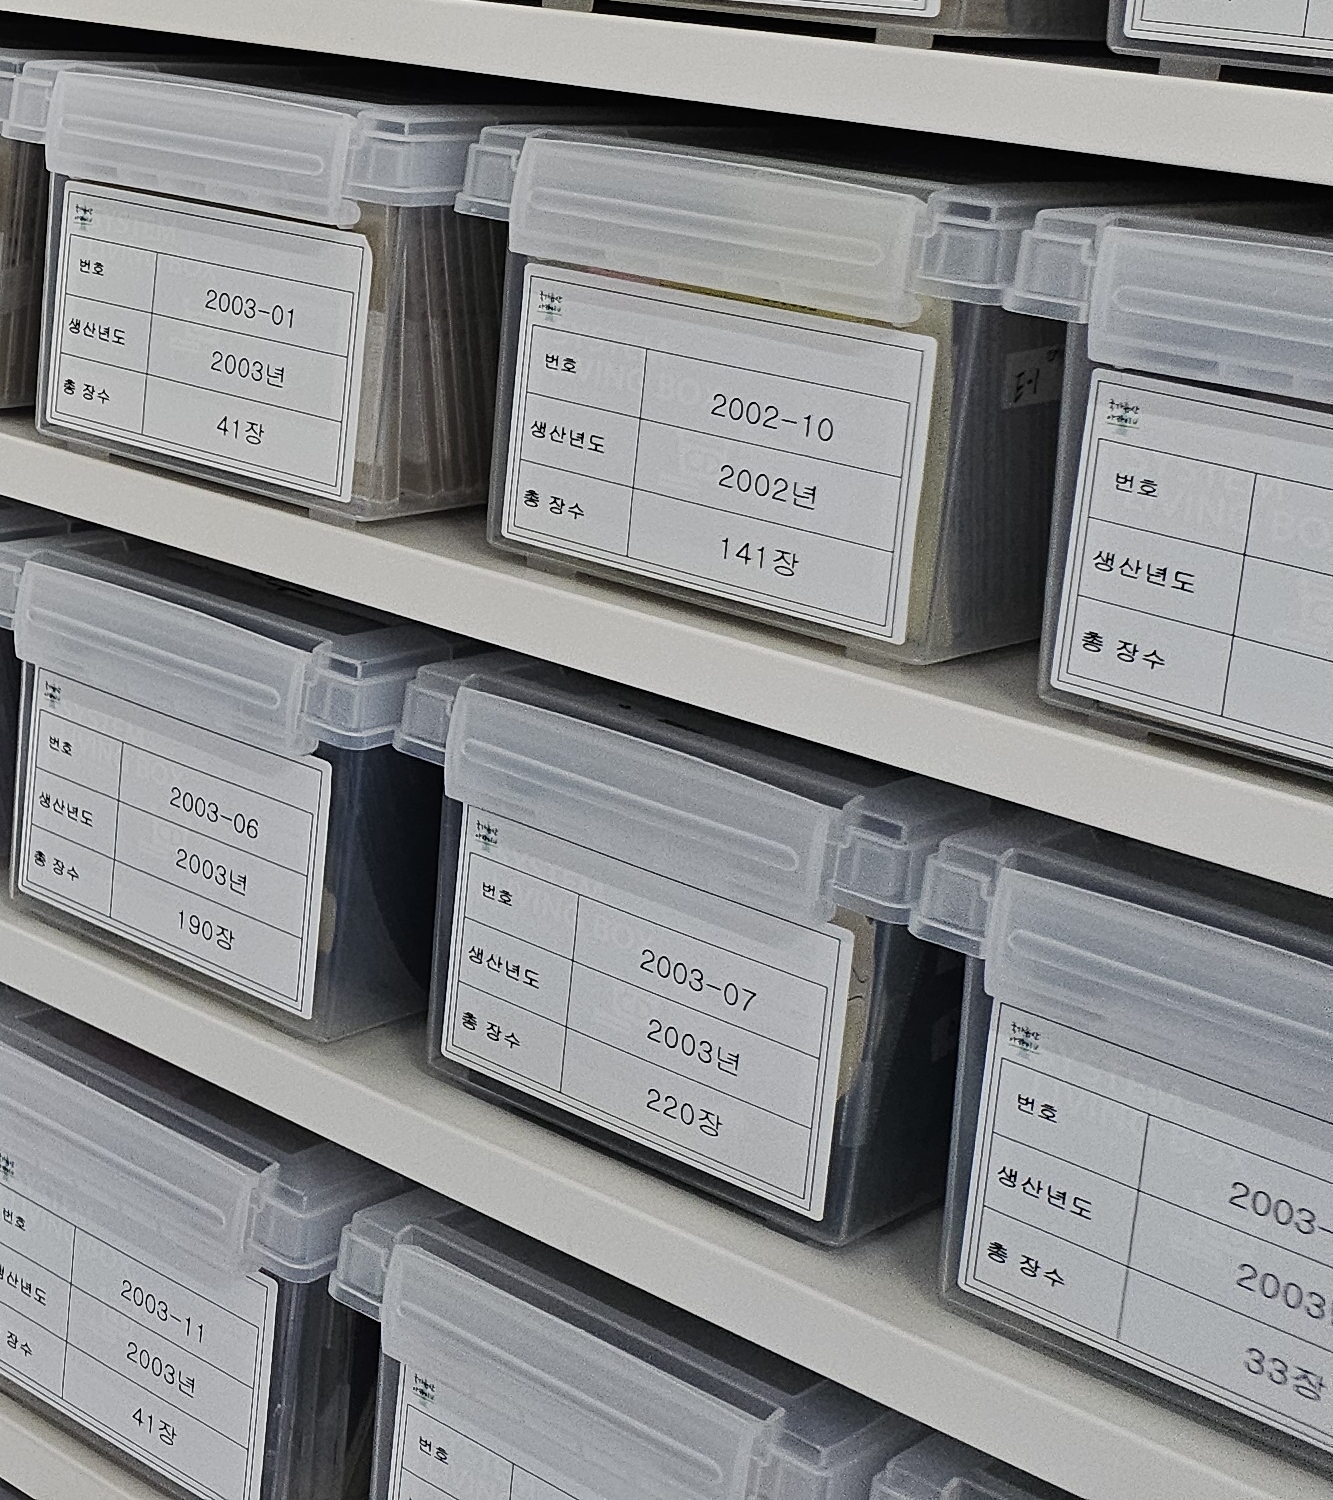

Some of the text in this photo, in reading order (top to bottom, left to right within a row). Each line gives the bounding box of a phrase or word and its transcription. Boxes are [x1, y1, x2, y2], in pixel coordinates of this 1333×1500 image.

[205, 289, 294, 328] 2003-01
[211, 350, 284, 388] 2003년
[216, 416, 265, 445] 41장
[711, 393, 834, 442] 2002-10
[718, 464, 817, 511] 2002년
[1114, 472, 1159, 499] 번호
[722, 538, 799, 577] 141장
[1092, 551, 1196, 594] 생산년도
[1081, 631, 1166, 671] 총 장수
[170, 786, 258, 839] 2003-06
[175, 848, 247, 897] 2003년
[179, 909, 235, 951] 190장
[482, 881, 757, 1011] 번호 2003-07
[468, 946, 739, 1077] 생산년도 2003년
[462, 1011, 723, 1137] 총 장수 220장
[1016, 1093, 1058, 1125] 번호
[996, 1166, 1333, 1320] 생산년도 2003
[121, 1280, 203, 1344] 2003-11
[986, 1241, 1326, 1402] 총 장수 33장
[126, 1341, 195, 1399] 2003년
[132, 1408, 177, 1446] 41장
[419, 1435, 449, 1466] 번호
